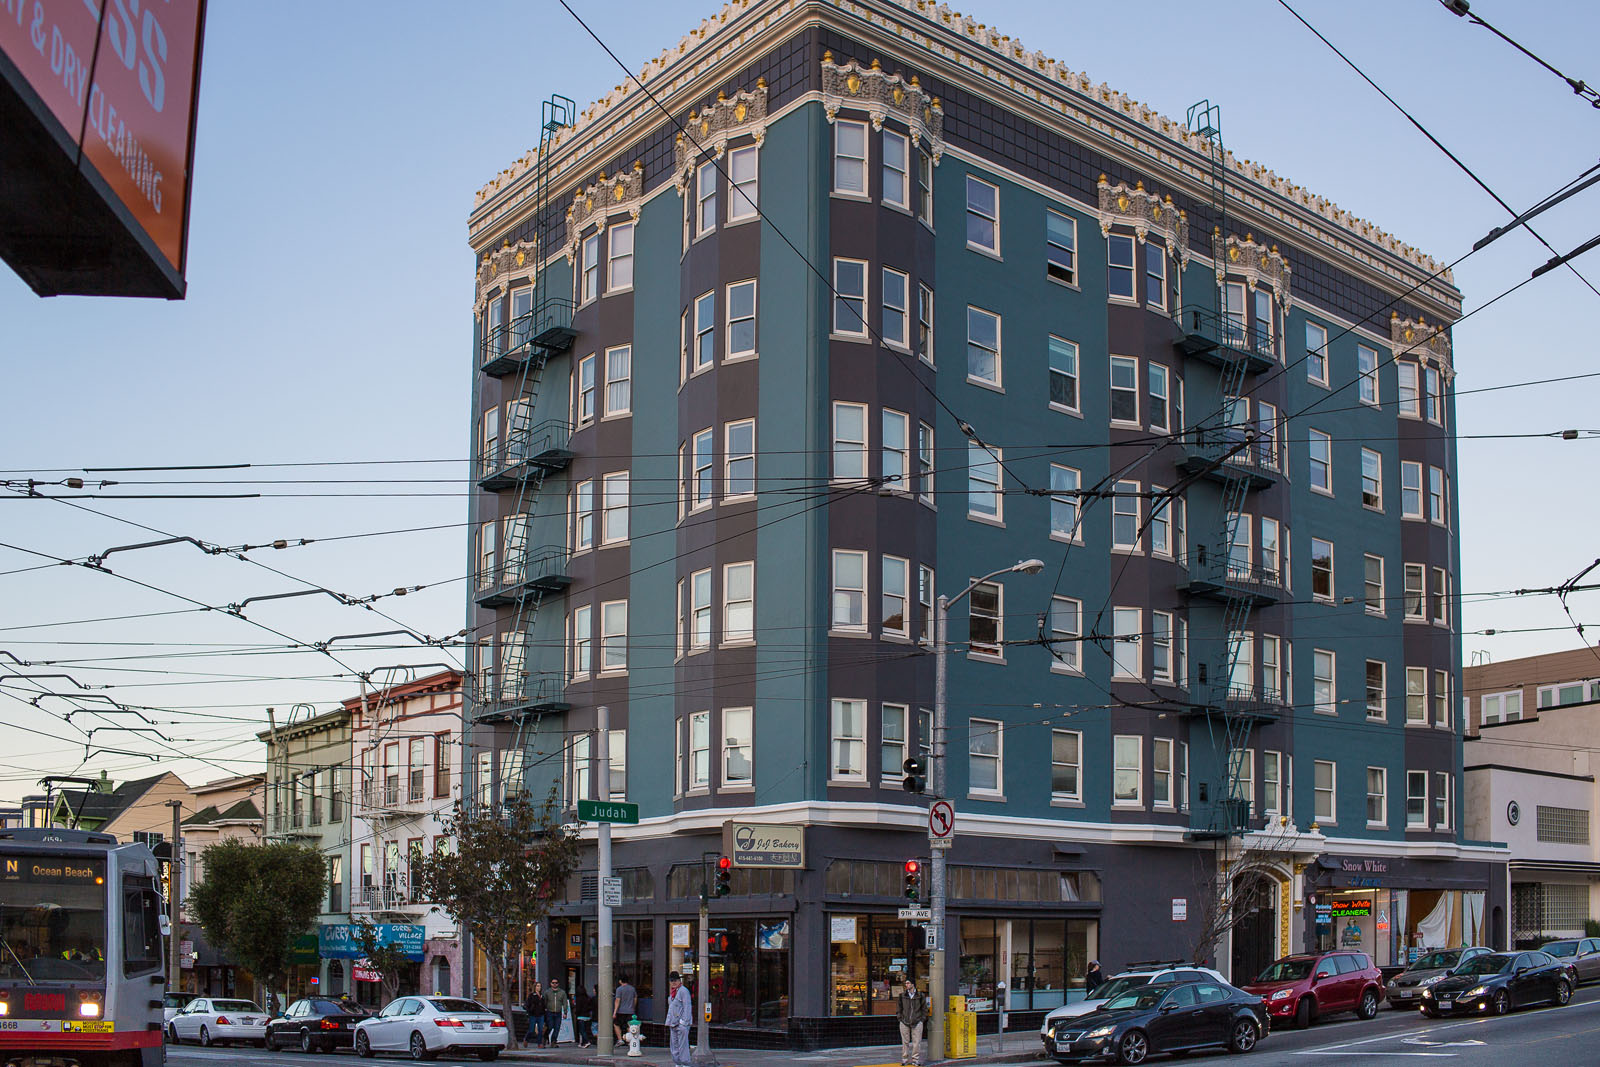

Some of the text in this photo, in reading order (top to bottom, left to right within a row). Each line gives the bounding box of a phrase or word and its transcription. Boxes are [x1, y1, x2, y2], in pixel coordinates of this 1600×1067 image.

[83, 0, 168, 112] SS
[50, 24, 88, 107] DRY
[88, 82, 163, 214] CLEANING
[591, 805, 627, 819] Judah
[772, 839, 800, 850] Bakery
[7, 860, 93, 878] N Ocean Beach
[1342, 859, 1387, 873] Snow White
[1332, 901, 1349, 909] Snow
[1351, 900, 1371, 908] White
[1332, 909, 1369, 917] CLEANERS
[325, 926, 349, 942] CURRY
[398, 932, 423, 940] VILLAGE
[0, 1021, 18, 1030] 66B
